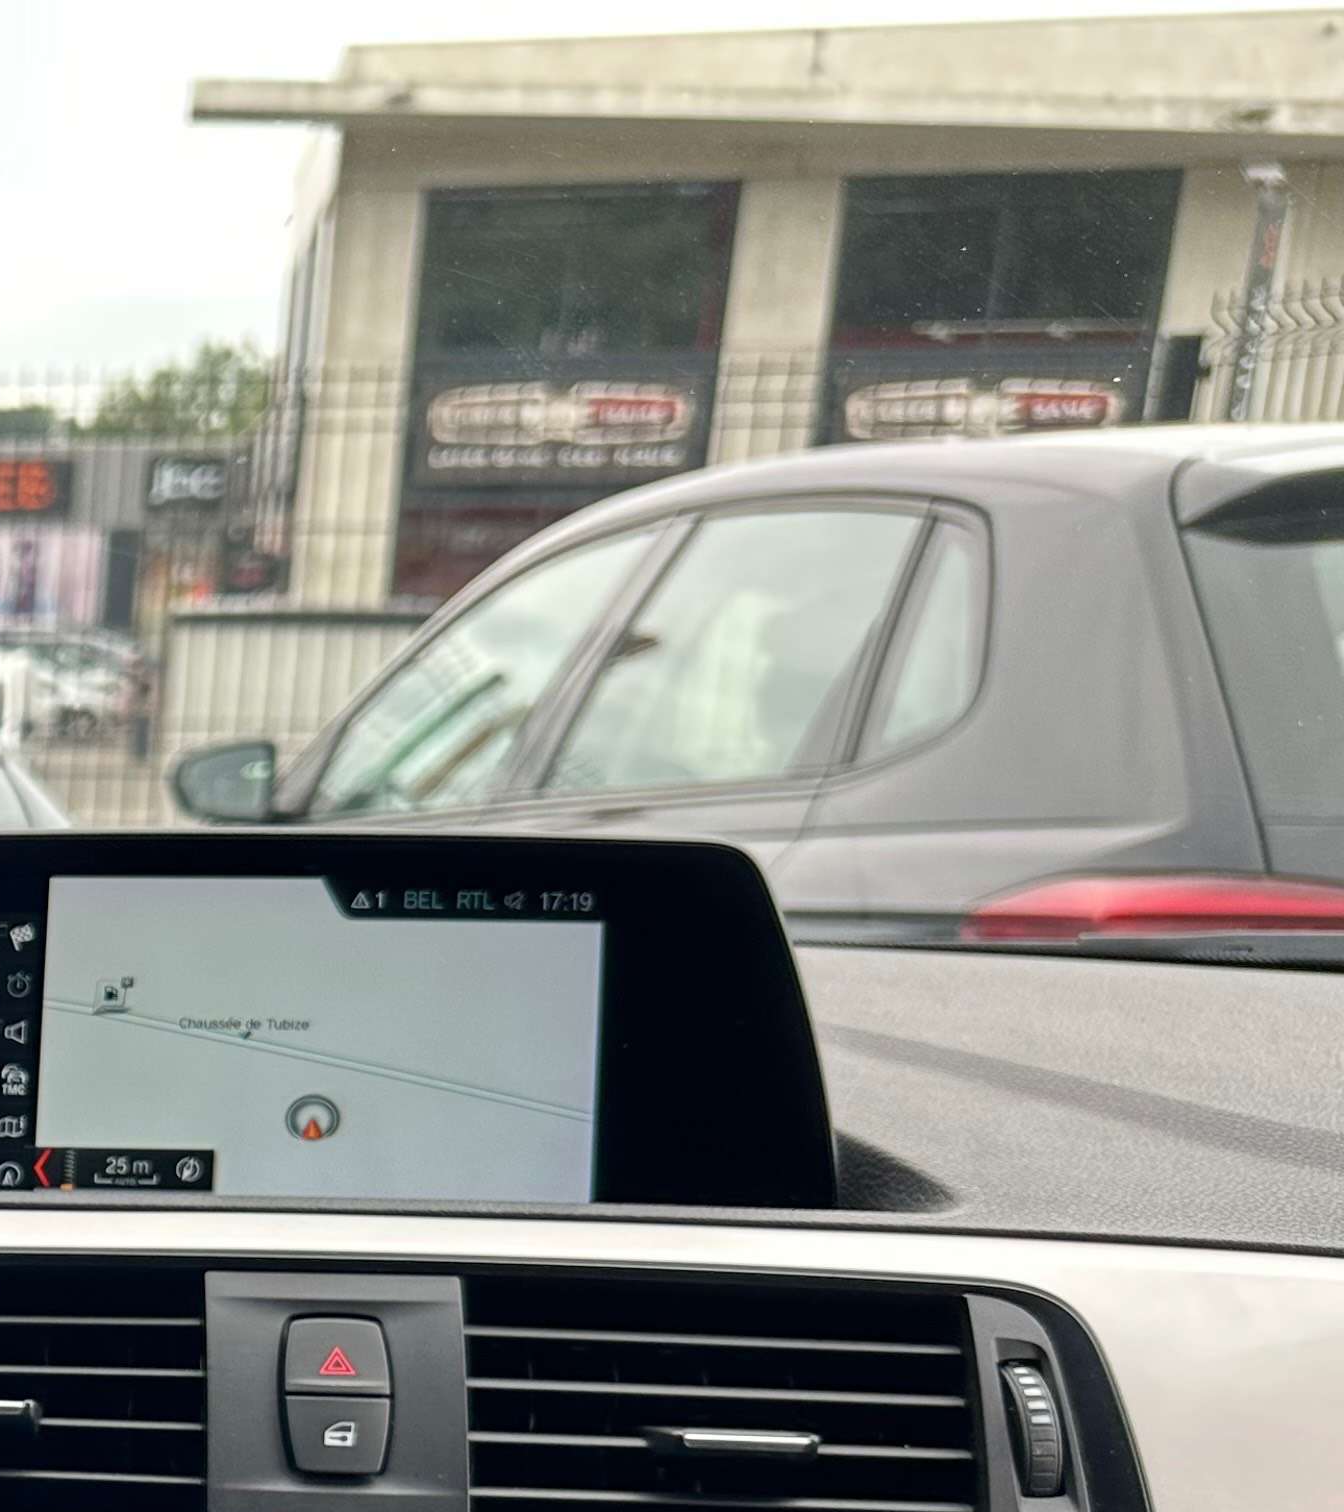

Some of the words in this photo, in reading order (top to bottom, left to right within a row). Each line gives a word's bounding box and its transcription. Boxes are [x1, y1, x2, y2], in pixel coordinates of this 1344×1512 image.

[375, 891, 385, 909] 1
[403, 891, 444, 910] BEL
[456, 891, 496, 911] RTL
[539, 892, 594, 912] 17:19
[246, 1016, 262, 1031] de
[267, 1017, 310, 1032] Tubize
[105, 1156, 128, 1175] 25
[132, 1159, 150, 1175] m
